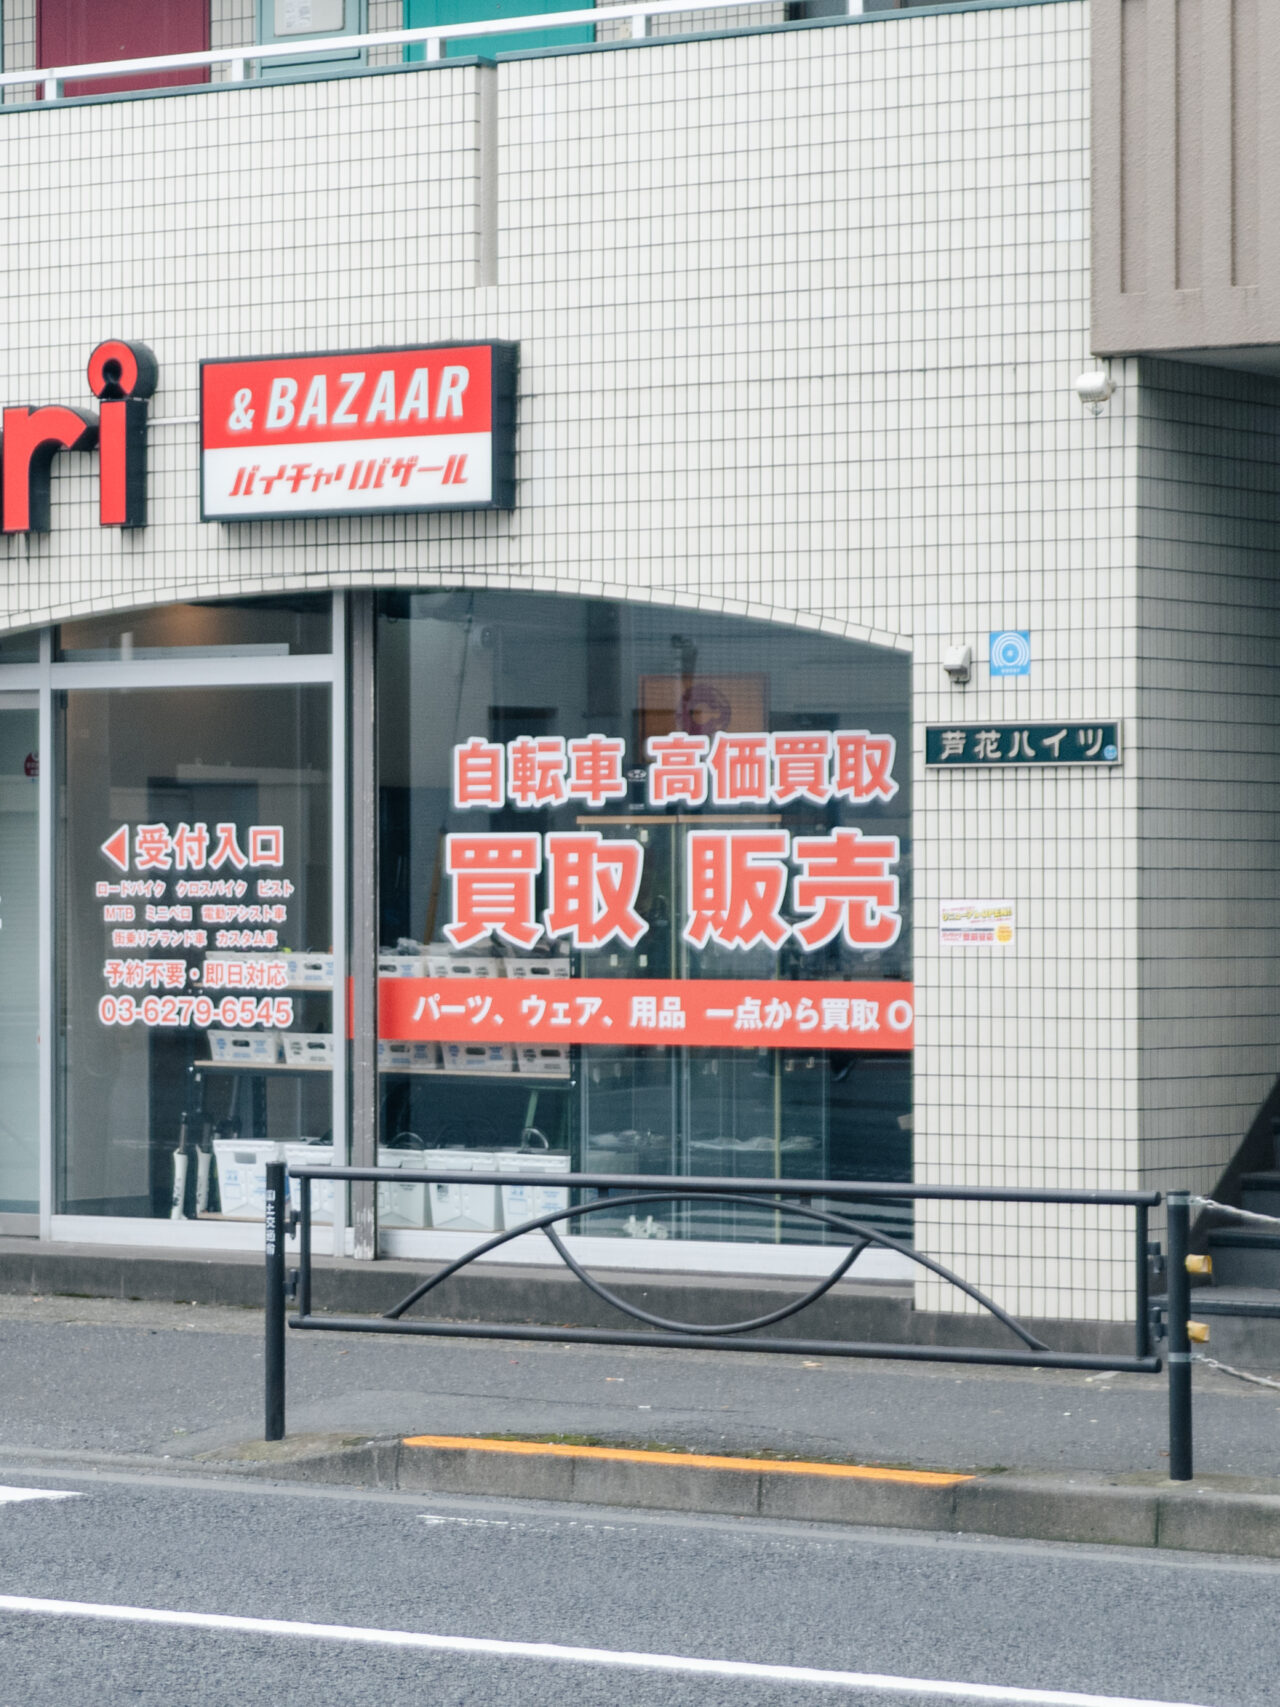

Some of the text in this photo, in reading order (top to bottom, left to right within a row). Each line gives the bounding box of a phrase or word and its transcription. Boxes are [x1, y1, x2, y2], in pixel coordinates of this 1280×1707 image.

[228, 365, 470, 432] & BAZAAR
[229, 453, 469, 497] バイチャリバザール
[940, 728, 1104, 760] 芦花ハイツ
[454, 730, 899, 808] 自転車 高価買取
[136, 823, 283, 870] 受付入口
[96, 880, 166, 897] ロードバイク
[176, 880, 248, 897] クロスバイク
[443, 827, 902, 951] 買取 販売
[104, 905, 287, 922] MTB ミニベロ 電動アシスト車
[216, 930, 278, 947] カスタム車
[99, 995, 295, 1028] 03-6279-6545
